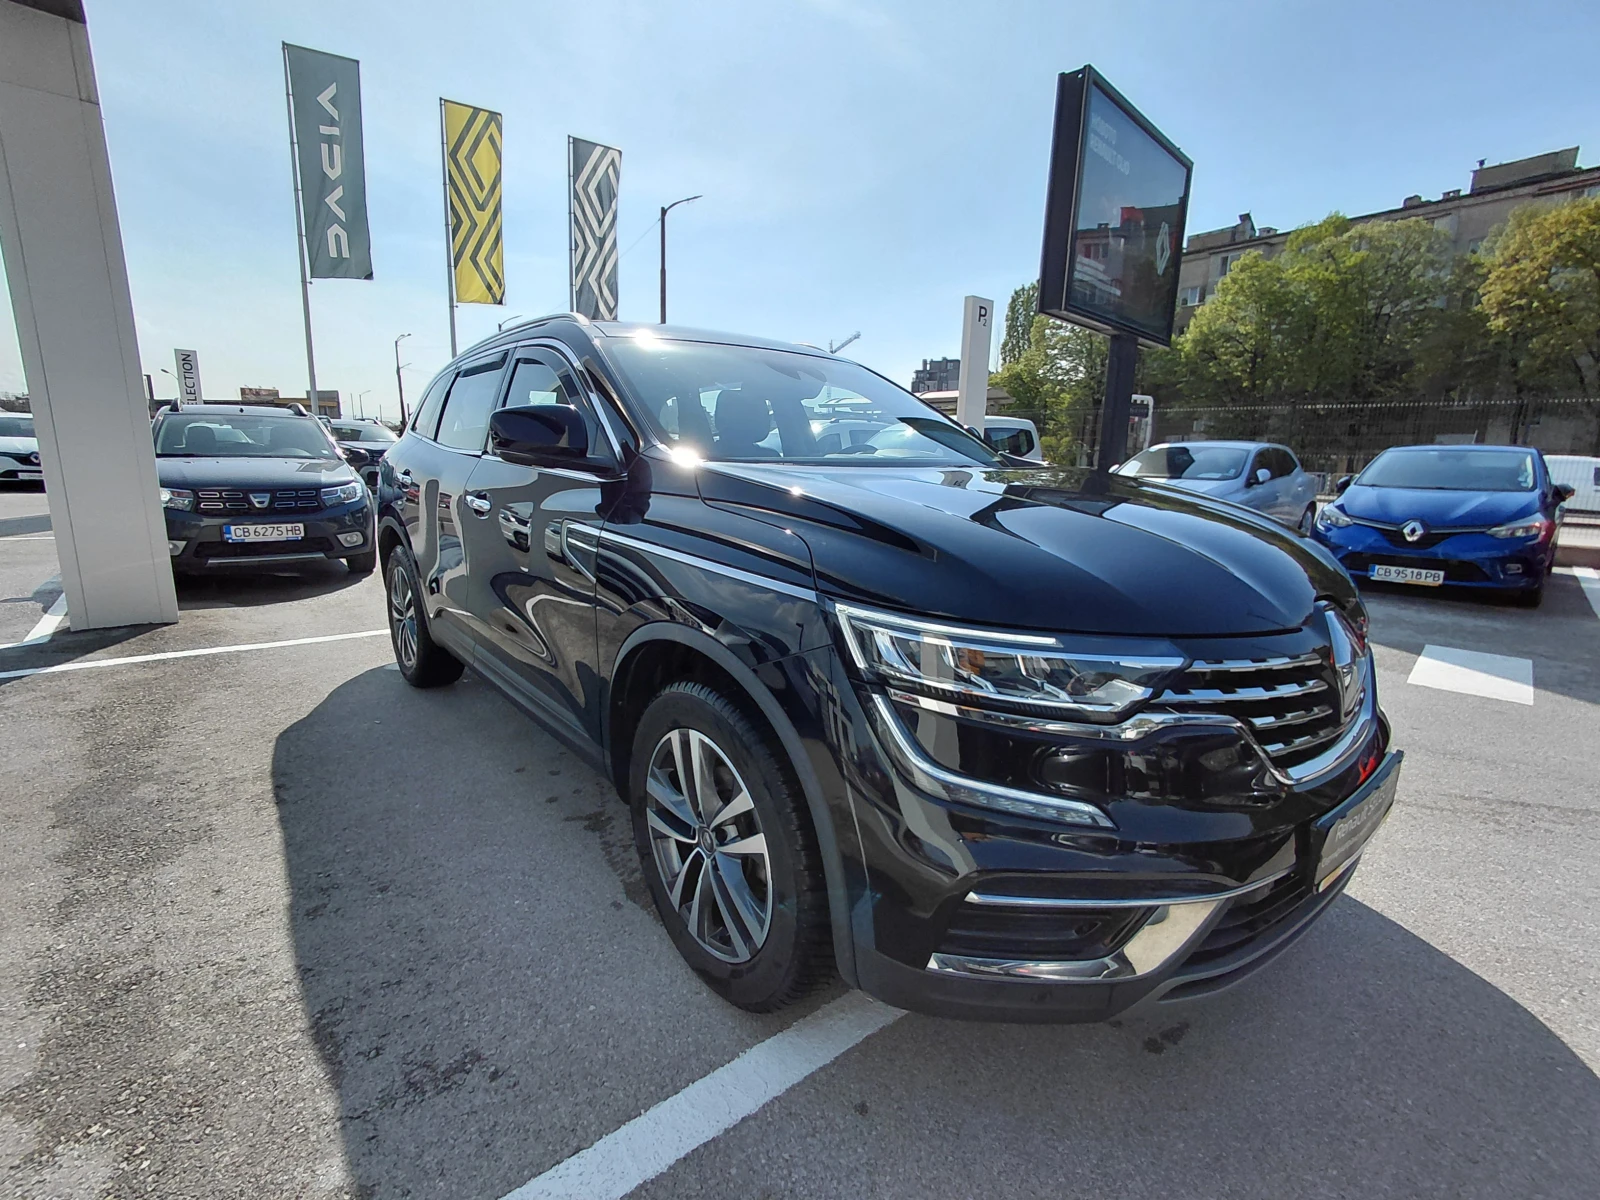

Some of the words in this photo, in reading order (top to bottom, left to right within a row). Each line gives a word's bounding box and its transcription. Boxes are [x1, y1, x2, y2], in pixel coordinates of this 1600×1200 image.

[234, 527, 251, 538] CB
[253, 526, 284, 538] 6275
[285, 525, 302, 536] HB
[1376, 567, 1392, 578] CB
[1394, 568, 1423, 580] 9518
[1424, 571, 1441, 582] PB
[1335, 804, 1369, 842] Renault
